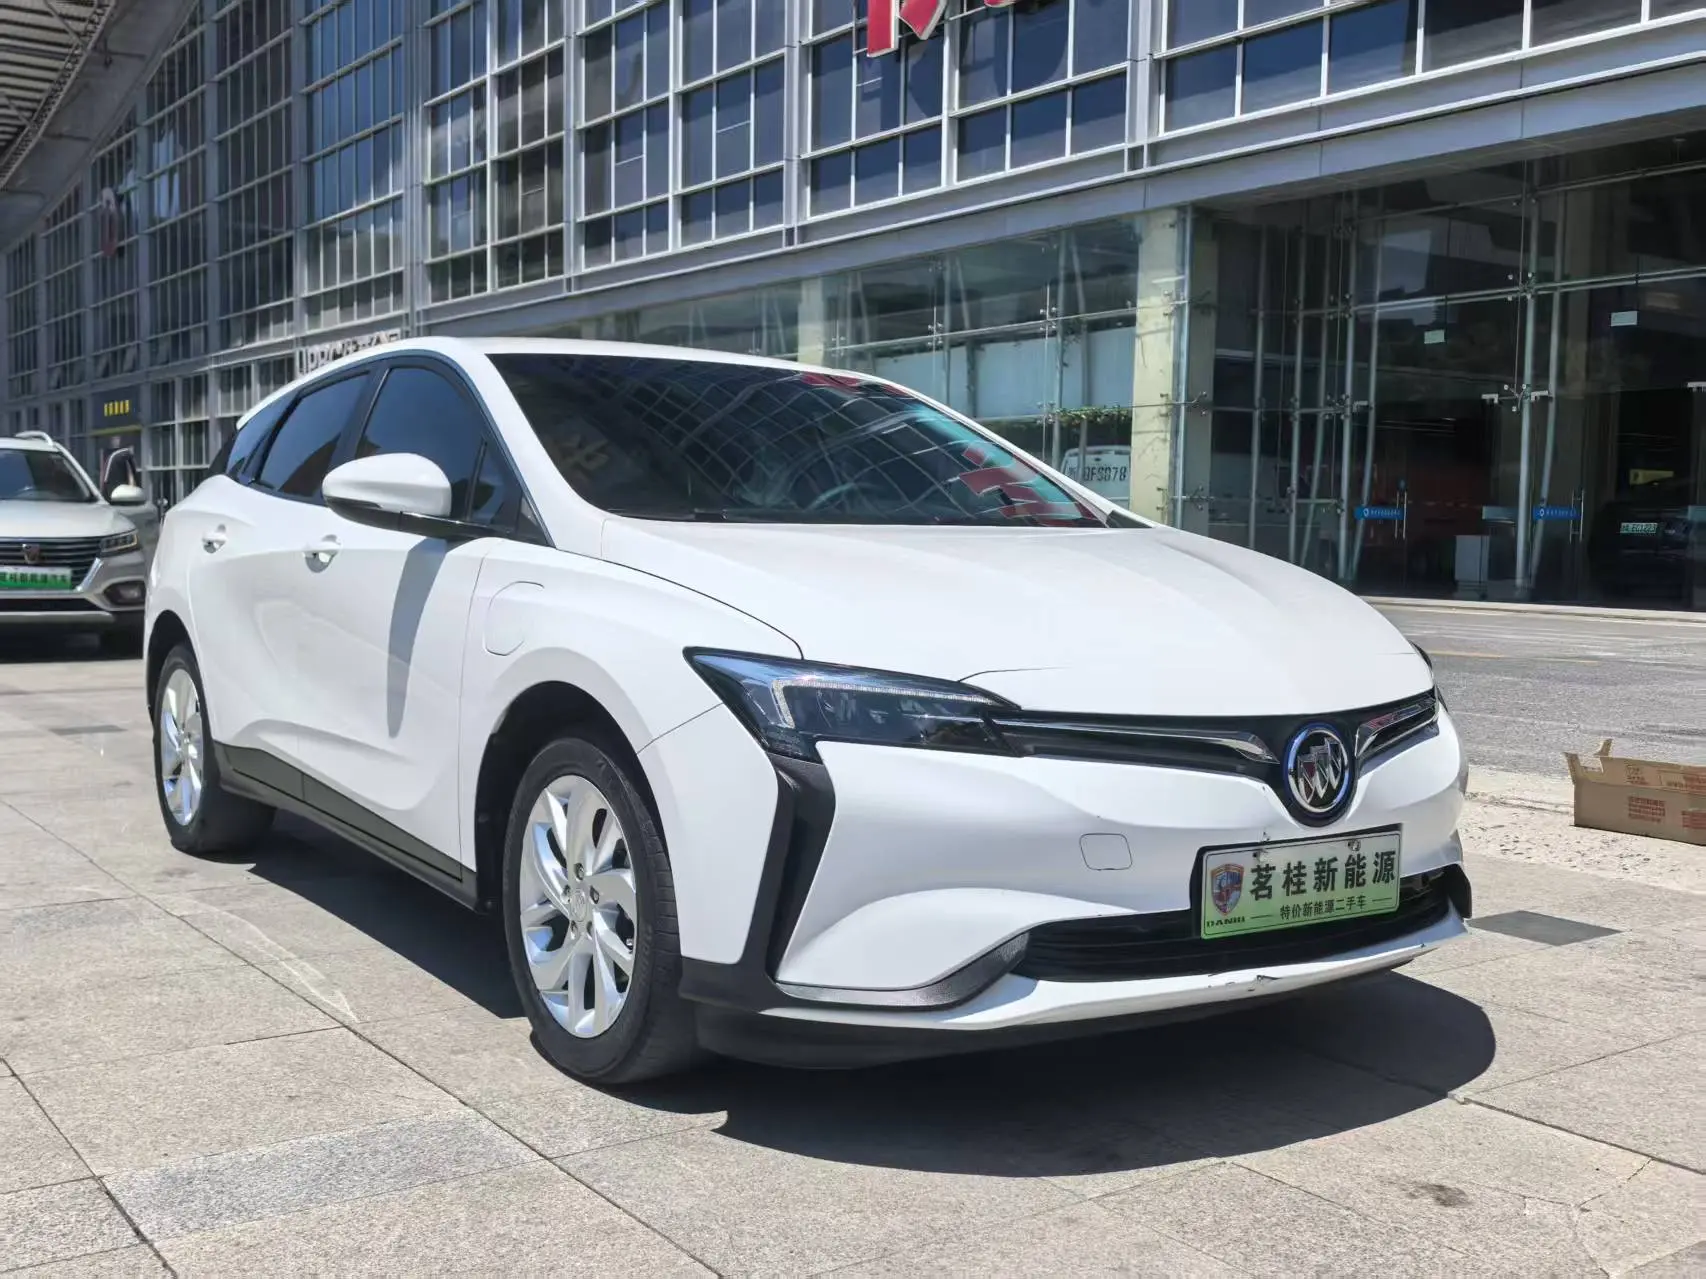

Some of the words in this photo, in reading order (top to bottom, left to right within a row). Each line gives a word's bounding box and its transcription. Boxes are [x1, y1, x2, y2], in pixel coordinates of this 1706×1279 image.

[1250, 850, 1396, 901] 茗桂新能源
[1280, 895, 1366, 920] 特价新能源二手车
